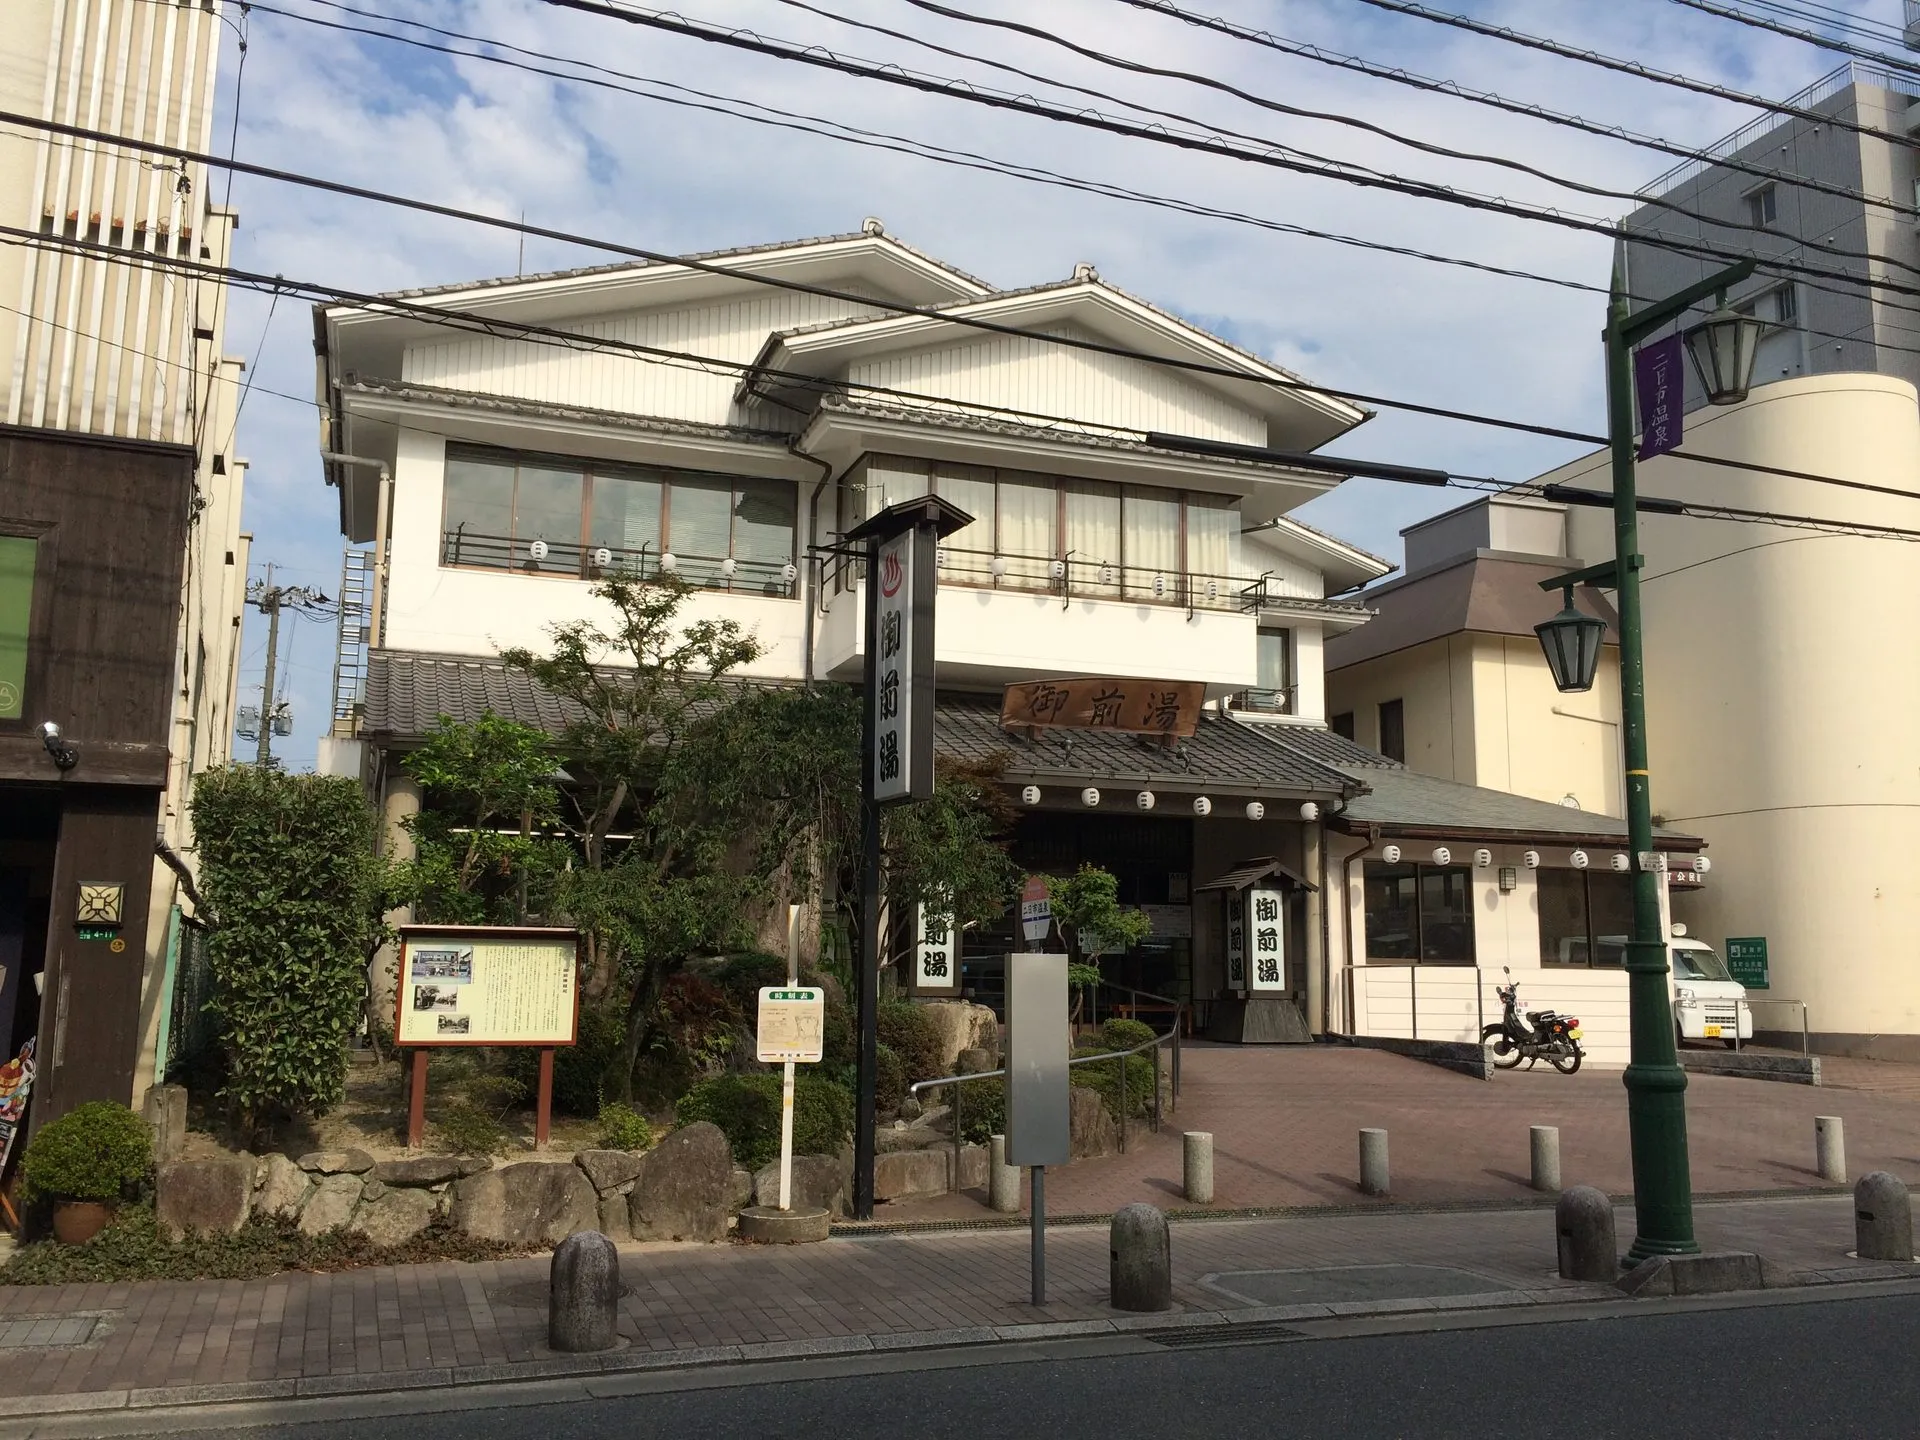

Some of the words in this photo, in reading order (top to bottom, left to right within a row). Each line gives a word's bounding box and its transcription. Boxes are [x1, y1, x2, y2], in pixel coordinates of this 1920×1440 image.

[1651, 353, 1670, 448] 二日市温泉
[879, 609, 902, 783] 御前湯
[1028, 684, 1181, 730] 御前湯
[1023, 901, 1049, 916] 二日市温泉
[1230, 898, 1243, 982] 御前湯
[1256, 897, 1280, 983] 御前湯
[775, 992, 808, 1000] 時刻表
